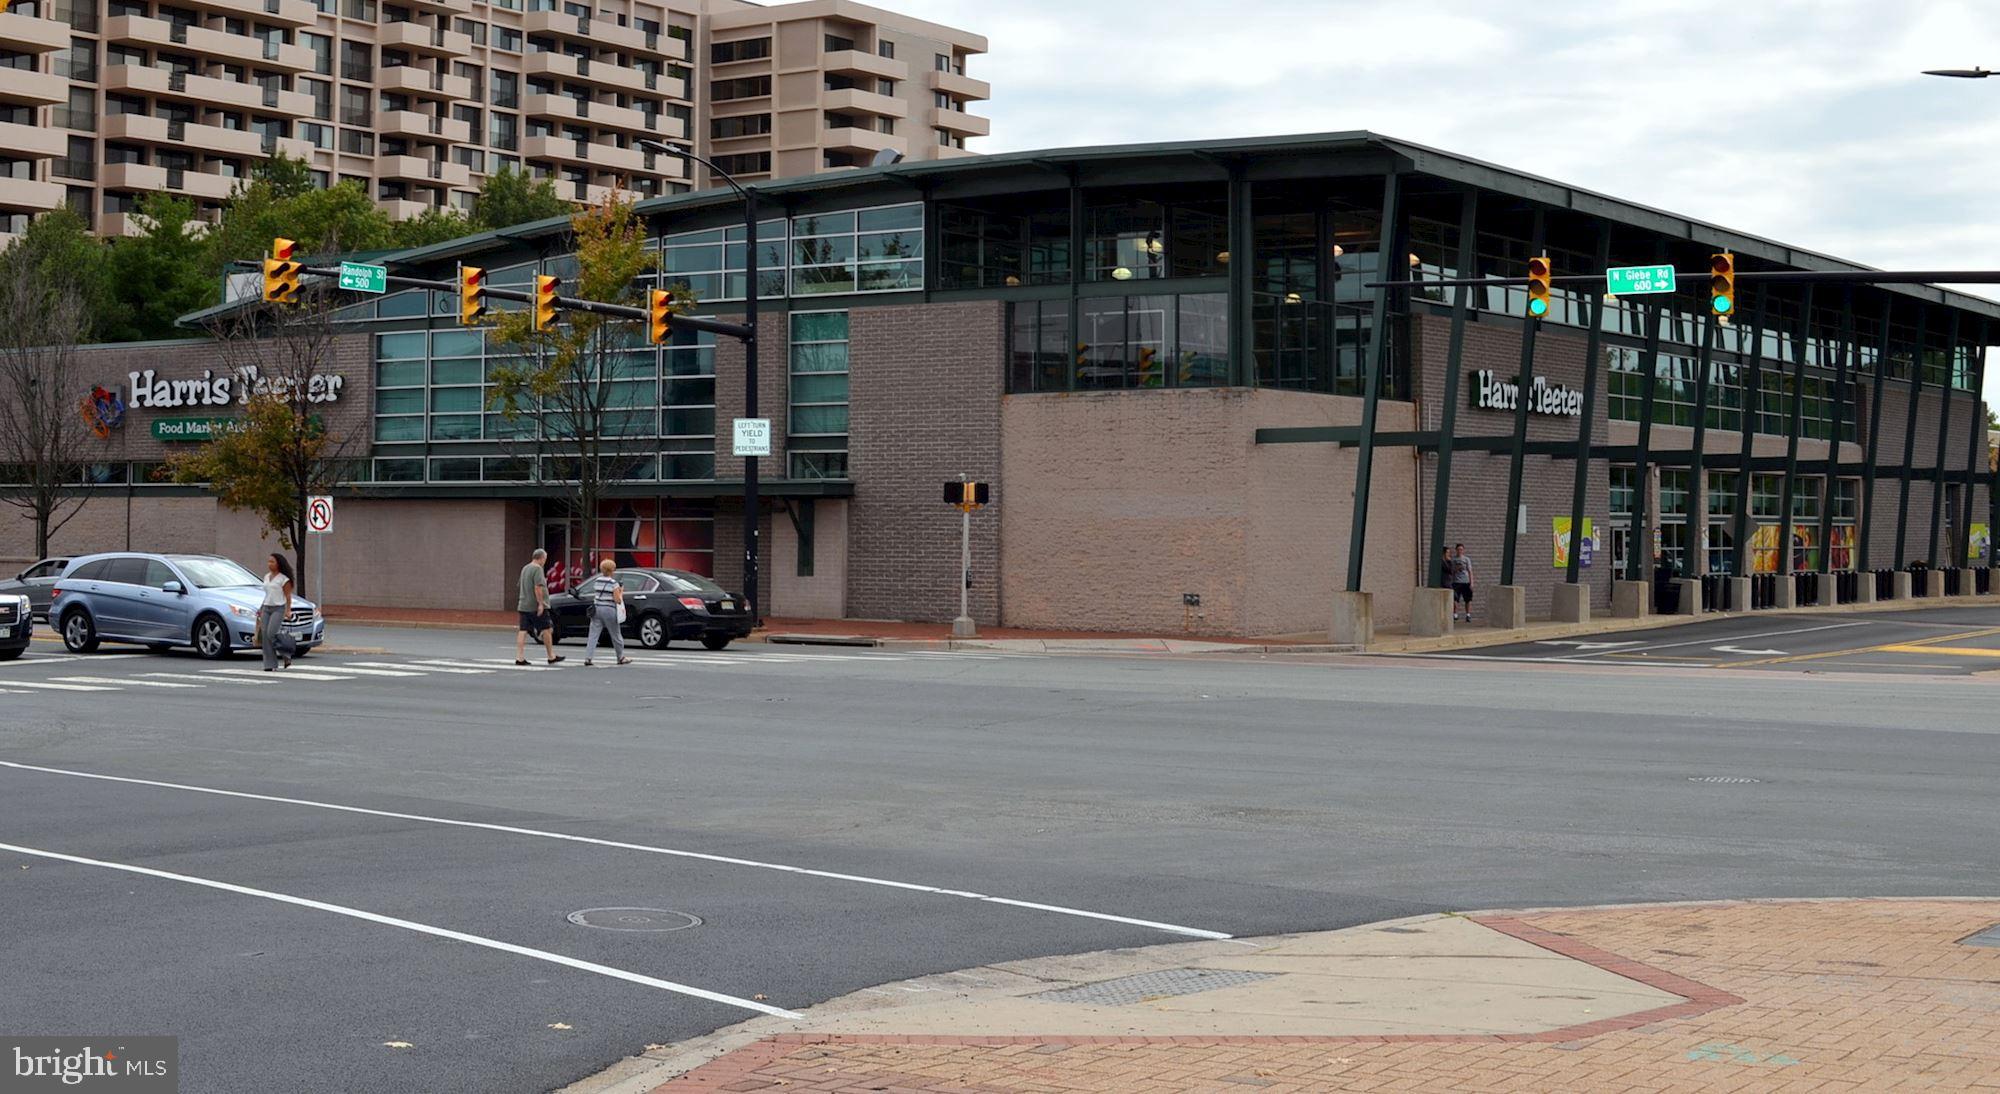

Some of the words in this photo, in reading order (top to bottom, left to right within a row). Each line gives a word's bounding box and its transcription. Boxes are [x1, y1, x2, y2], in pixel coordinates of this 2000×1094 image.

[342, 265, 373, 279] Randolph
[376, 269, 384, 280] St
[1613, 271, 1620, 280] N
[1625, 270, 1651, 280] Glebe
[1657, 268, 1669, 279] Rd
[355, 277, 370, 288] 500
[1633, 280, 1652, 290] 600
[128, 369, 230, 409] Harris
[1478, 369, 1533, 410] Harrs
[1533, 376, 1584, 416] Teeter
[159, 422, 184, 434] Food
[742, 429, 763, 437] YIELD
